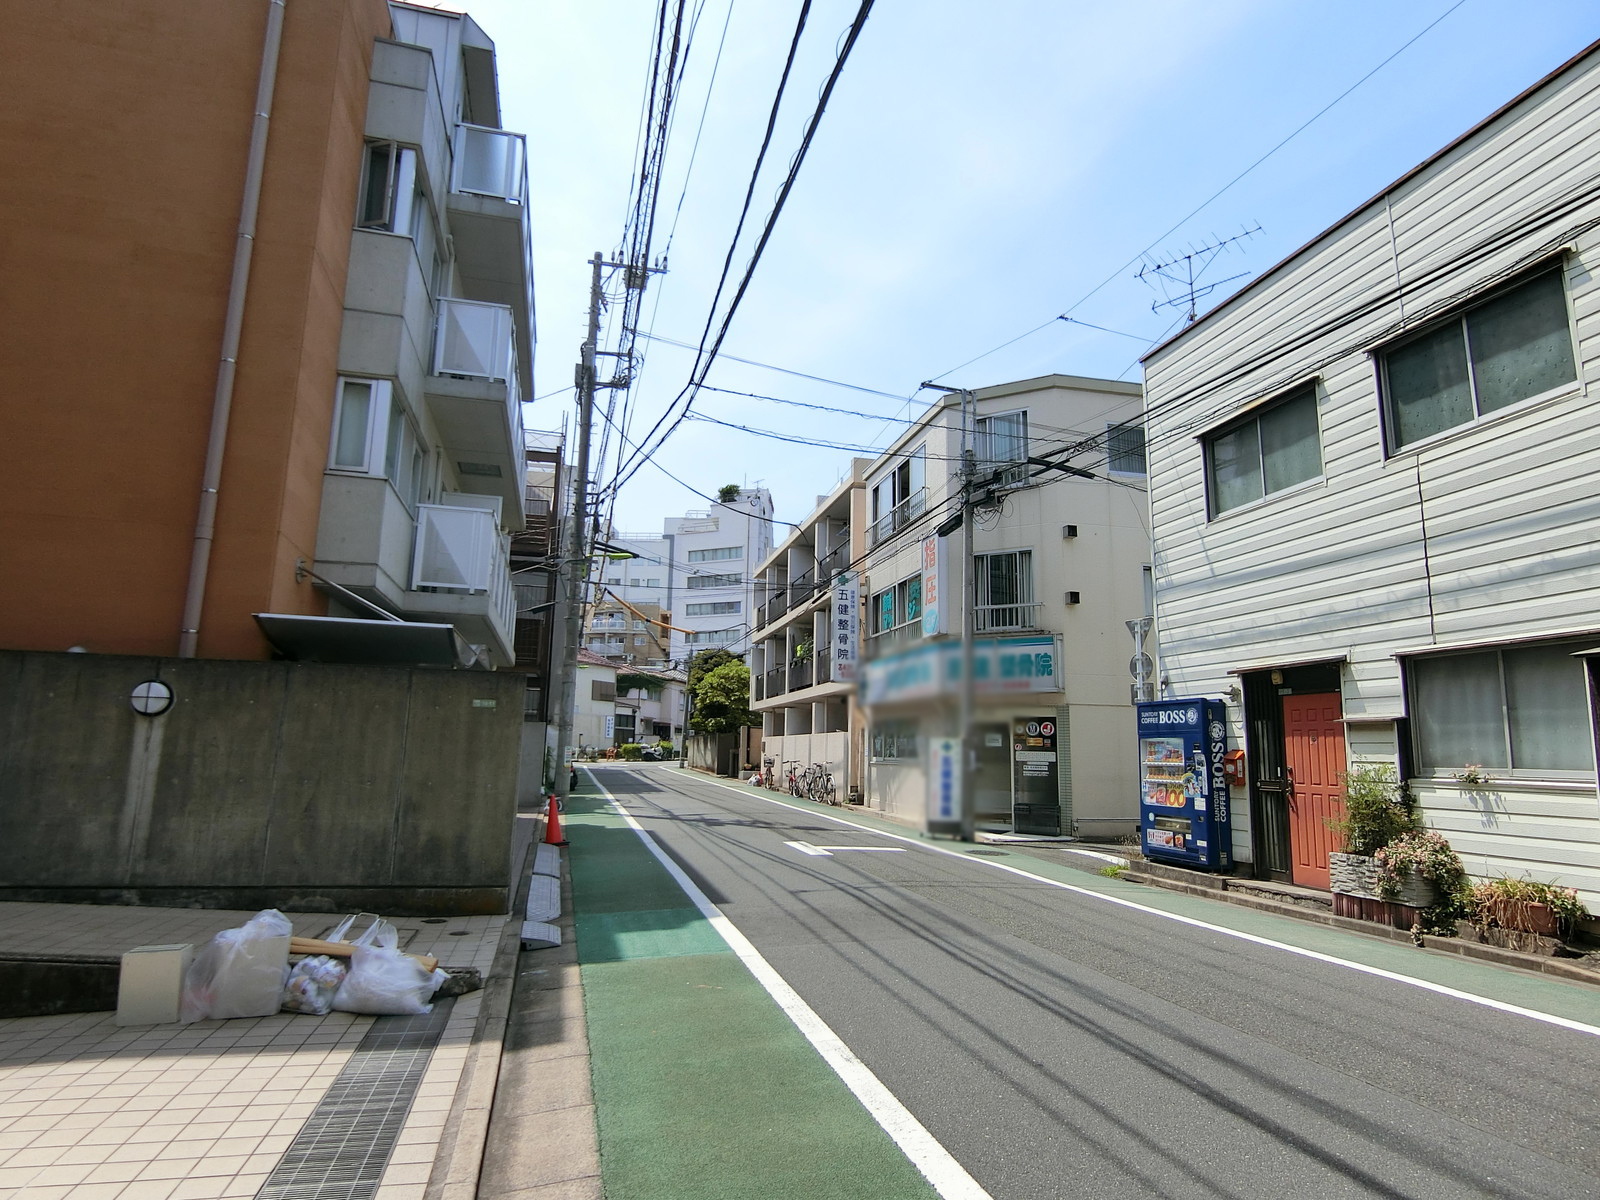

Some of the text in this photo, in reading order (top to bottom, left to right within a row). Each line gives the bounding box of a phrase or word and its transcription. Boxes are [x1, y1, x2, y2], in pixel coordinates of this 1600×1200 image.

[924, 537, 937, 607] 指圧
[837, 588, 849, 660] 五健整骨院
[1159, 710, 1186, 724] BOSS
[1211, 742, 1226, 788] BOSS
